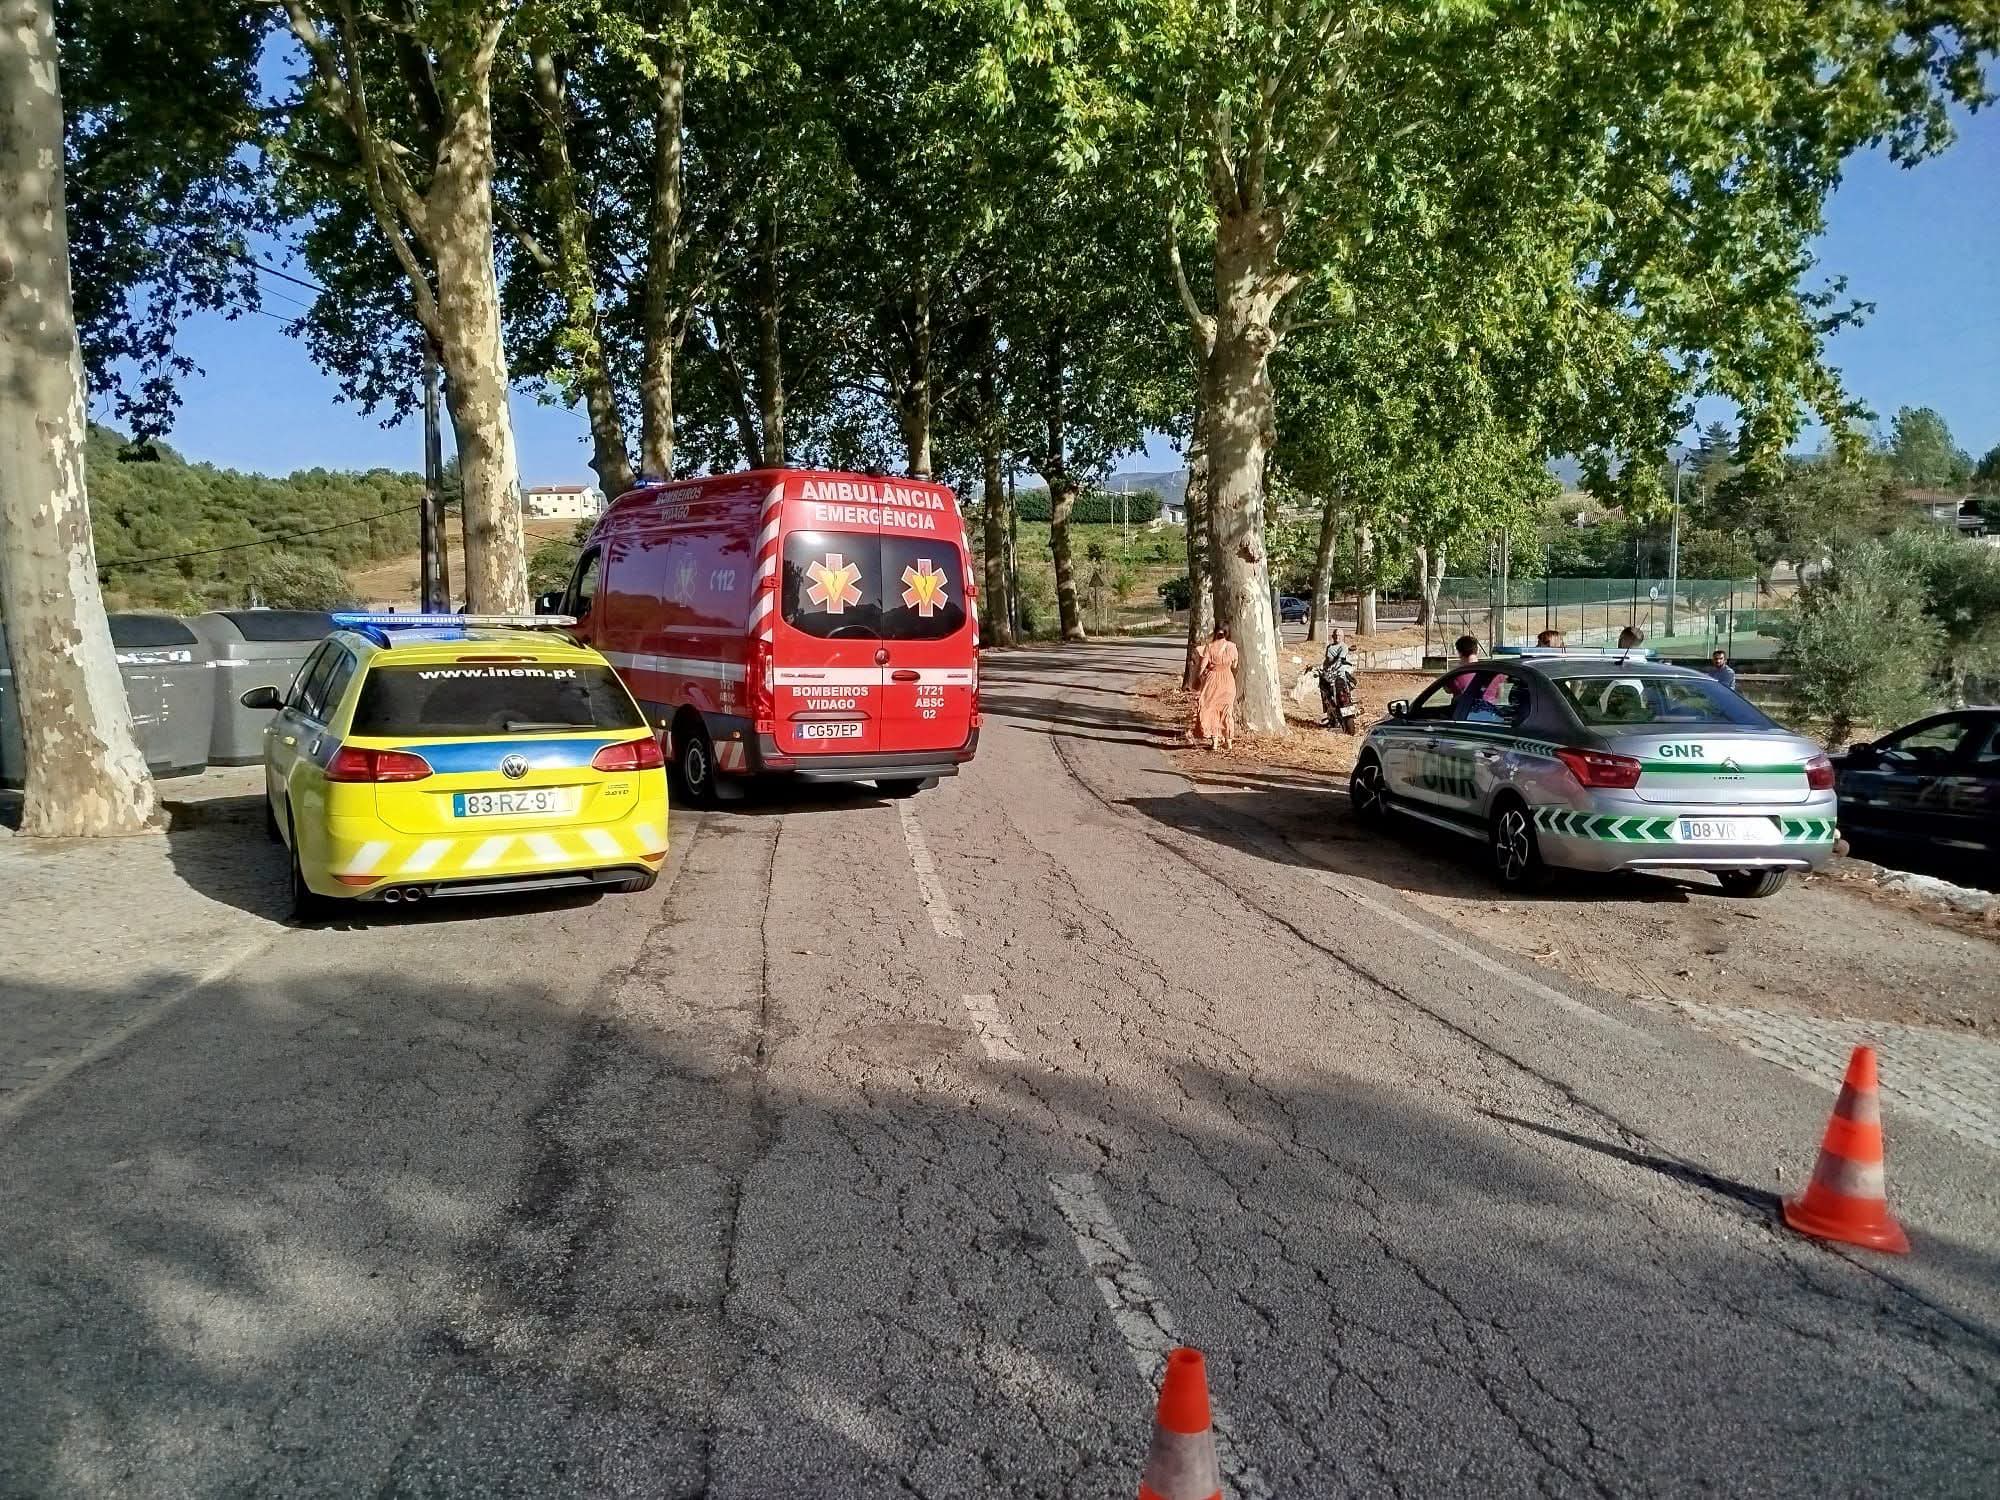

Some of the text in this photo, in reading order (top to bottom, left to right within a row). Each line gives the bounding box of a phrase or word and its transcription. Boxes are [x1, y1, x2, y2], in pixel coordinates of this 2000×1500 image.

[801, 480, 945, 511] AMBULÂNCIA
[815, 504, 936, 531] EMERGÊNCIA
[717, 569, 736, 591] 112
[418, 667, 577, 680] www.inem.pt
[792, 686, 869, 697] BOMBEIROS
[916, 685, 944, 696] 1721
[807, 699, 856, 710] VIDAGO
[915, 698, 945, 708] ABSC
[922, 710, 937, 719] 02
[1658, 744, 1705, 758] GNR
